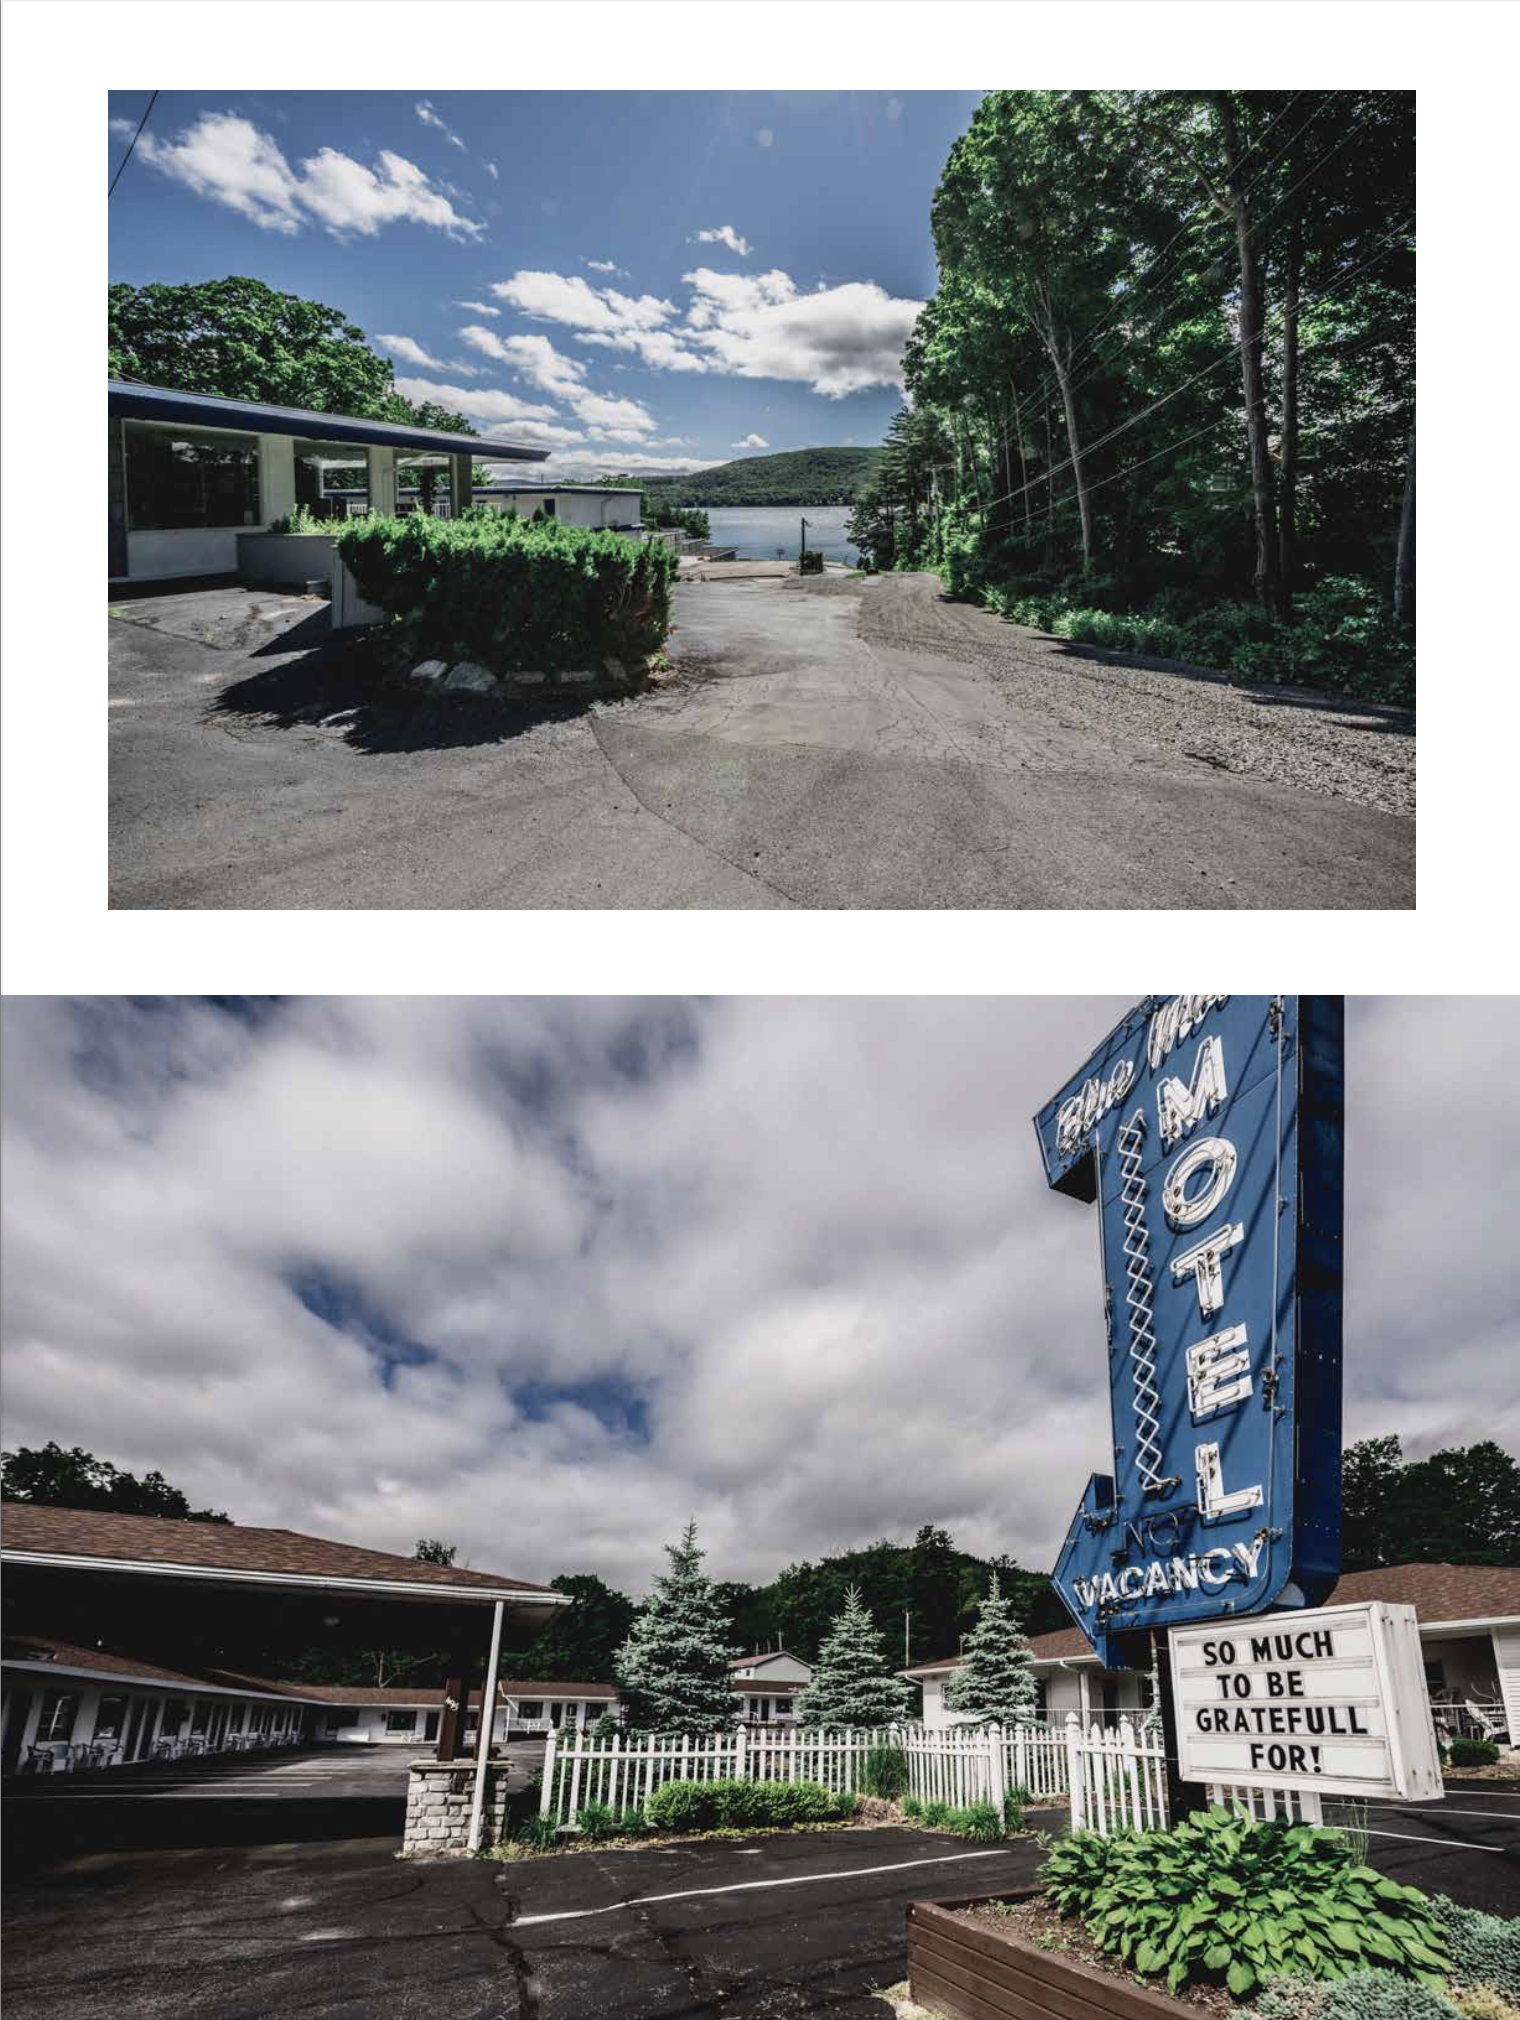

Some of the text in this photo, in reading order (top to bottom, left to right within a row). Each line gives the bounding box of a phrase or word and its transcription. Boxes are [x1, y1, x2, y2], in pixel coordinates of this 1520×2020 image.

[1157, 1034, 1264, 1519] MOTEL
[1123, 1511, 1180, 1554] NO
[1073, 1541, 1264, 1607] VACANCY
[1203, 1630, 1334, 1666] SO MUCH
[1217, 1671, 1304, 1699] TO BE
[1196, 1706, 1368, 1735] GRATEFULL
[1251, 1743, 1322, 1773] FOR!
